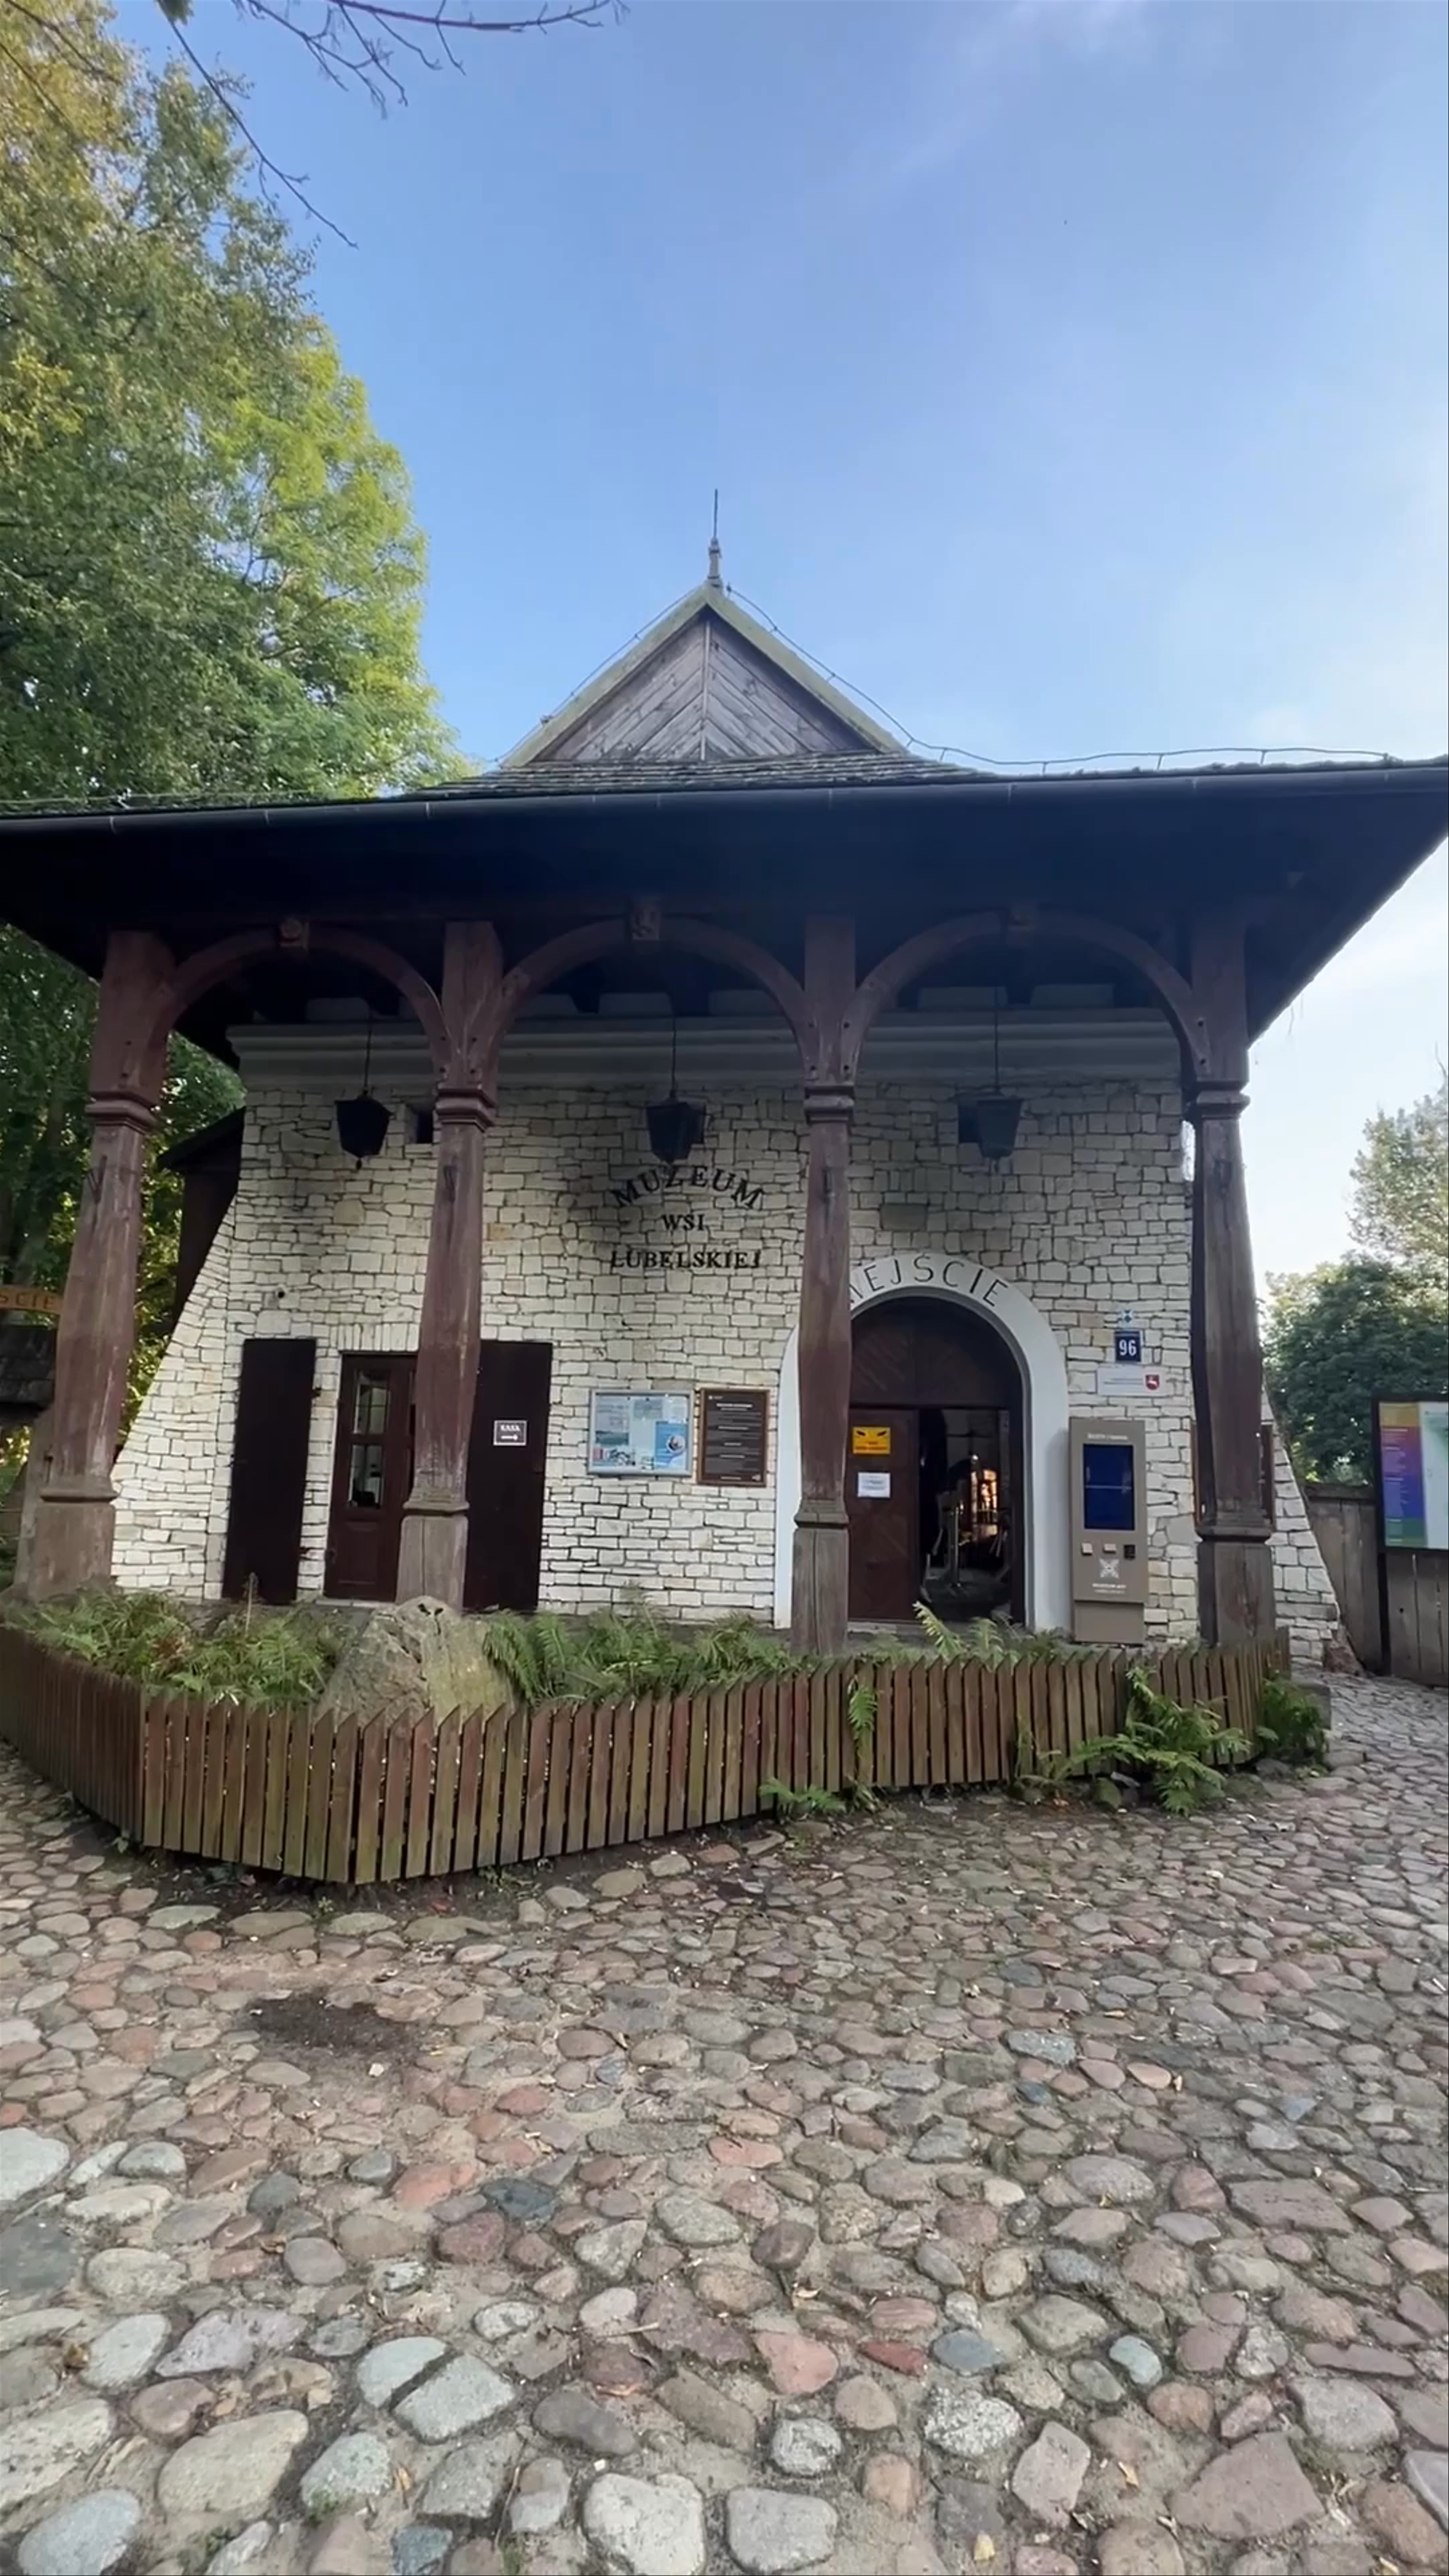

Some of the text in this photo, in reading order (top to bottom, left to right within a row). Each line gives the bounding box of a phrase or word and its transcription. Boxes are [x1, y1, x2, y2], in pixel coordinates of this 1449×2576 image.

[610, 1165, 764, 1210] MUZEUM
[662, 1214, 705, 1231] WSI
[611, 1249, 761, 1269] LUBELSKIEJ
[1119, 1340, 1137, 1356] 96
